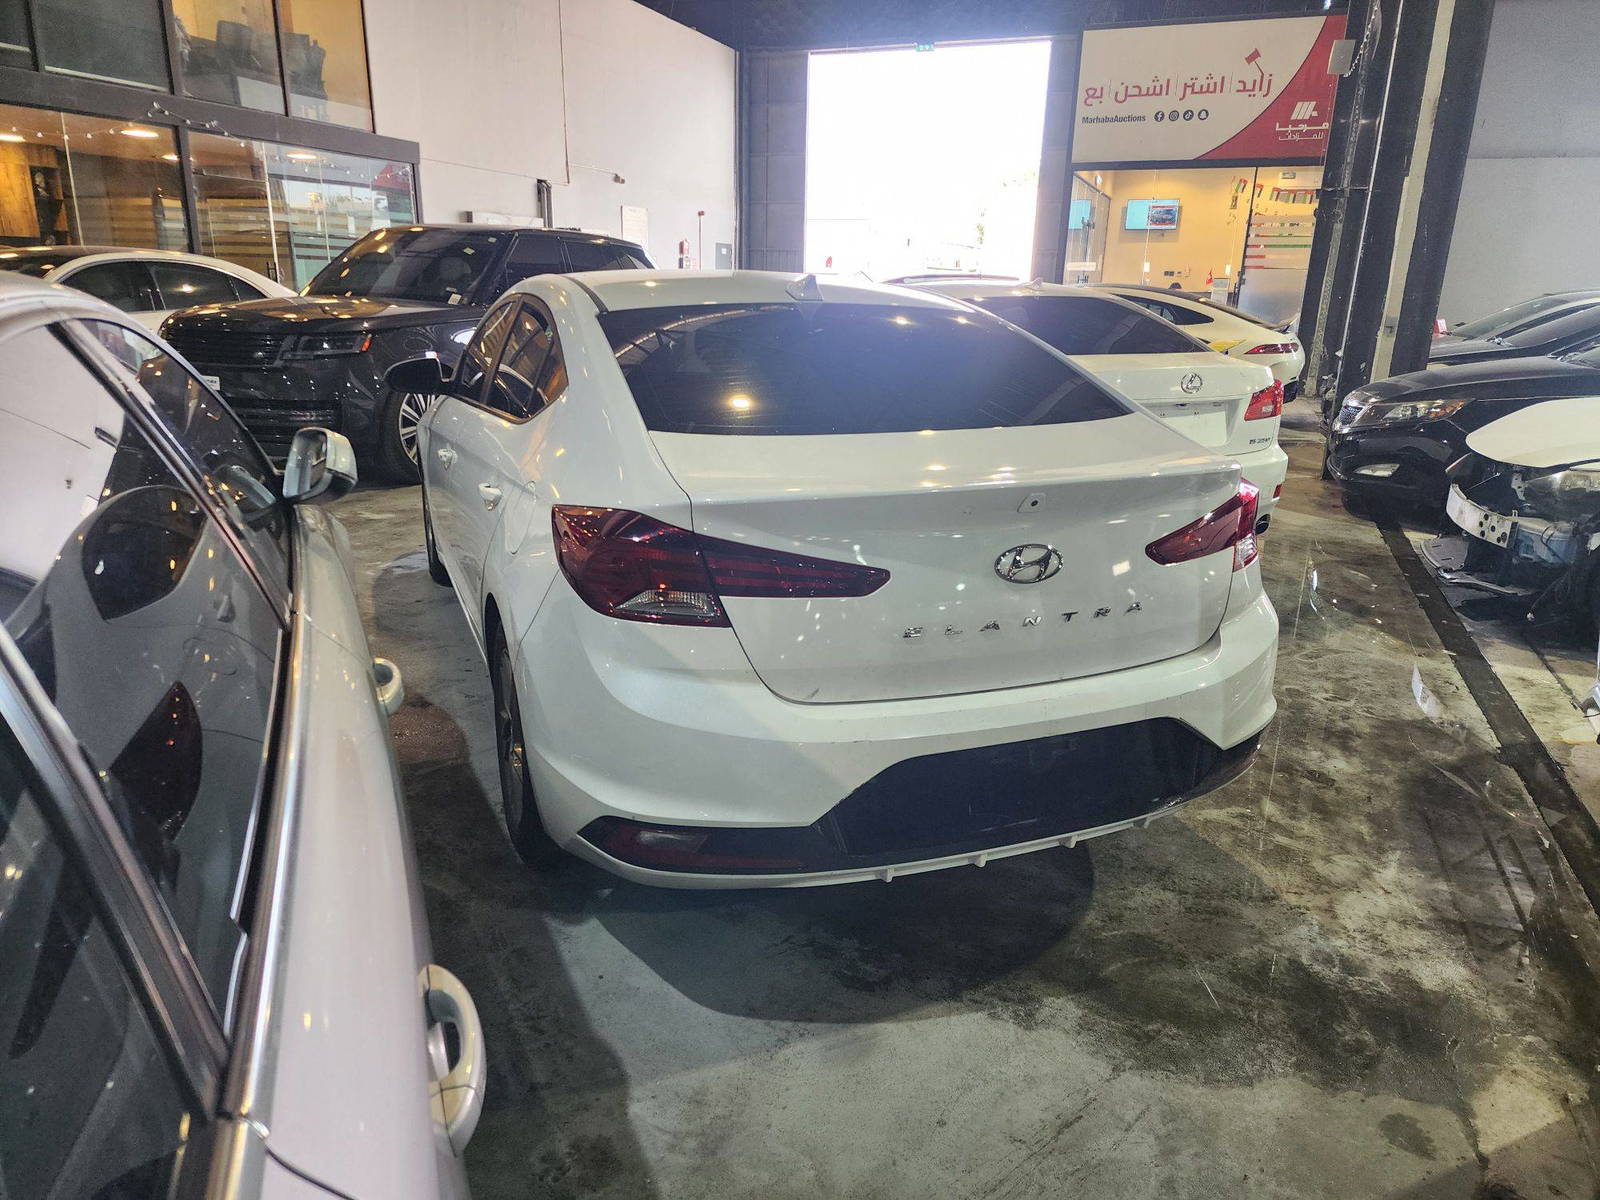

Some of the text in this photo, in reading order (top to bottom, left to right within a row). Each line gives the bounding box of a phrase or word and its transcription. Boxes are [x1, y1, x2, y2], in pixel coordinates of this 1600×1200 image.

[1084, 71, 1273, 107] زايد اشتر اشحن بع
[1081, 113, 1146, 124] MarhabaAuctions
[903, 601, 1142, 638] ELANTRA
